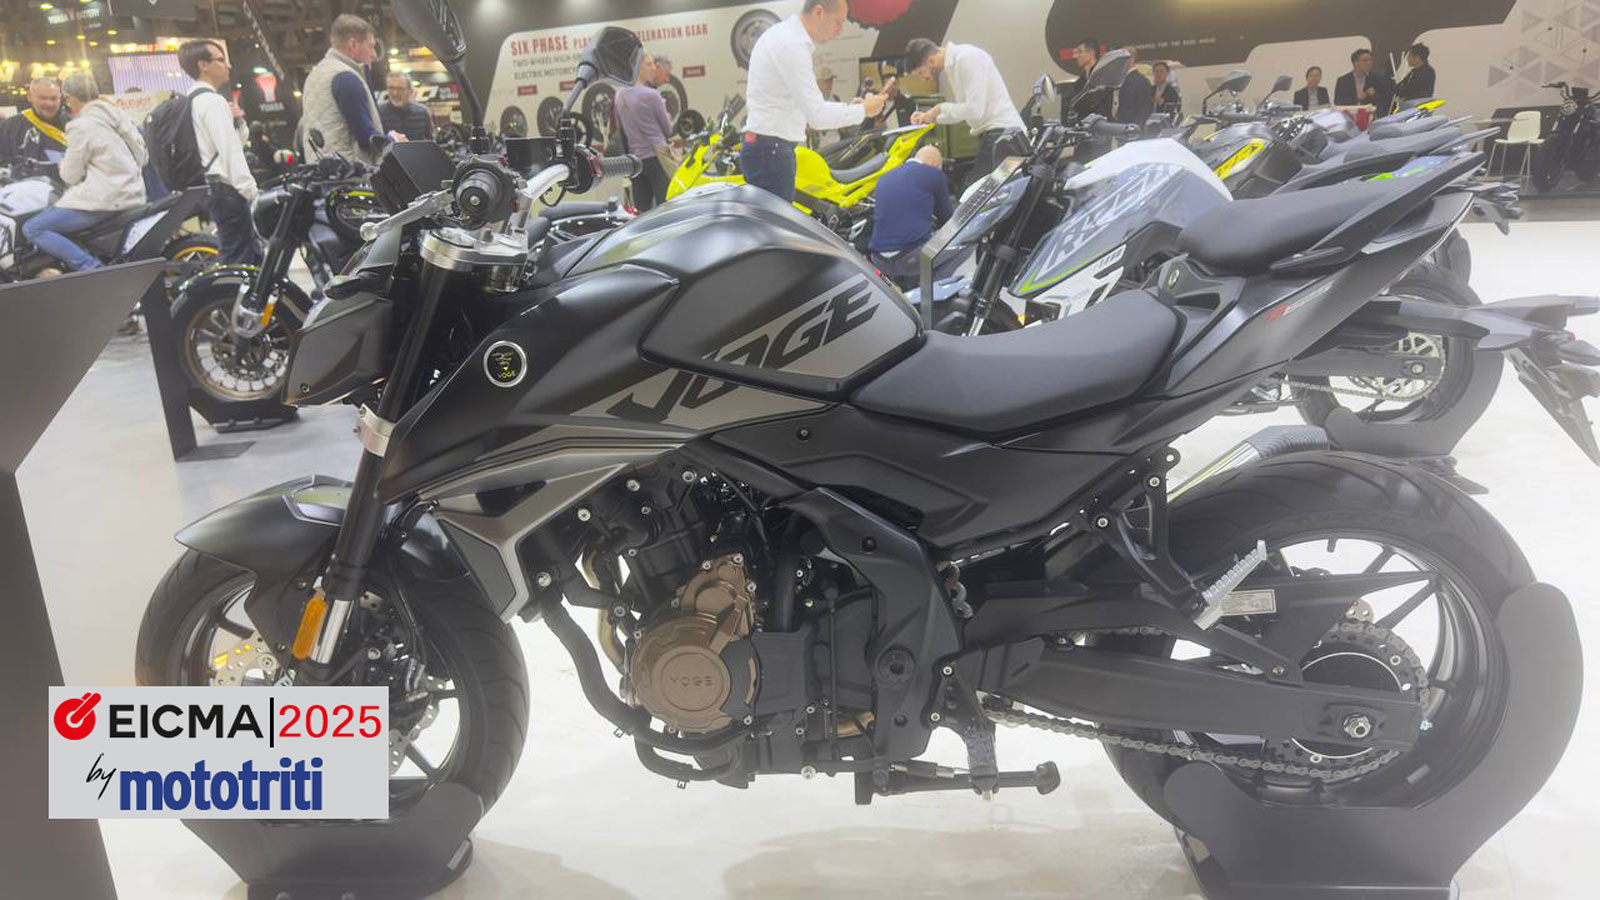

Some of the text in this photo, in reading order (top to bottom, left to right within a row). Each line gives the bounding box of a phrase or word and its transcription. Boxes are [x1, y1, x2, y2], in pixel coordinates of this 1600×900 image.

[511, 40, 529, 56] SIX
[532, 35, 568, 54] PHASE
[685, 23, 708, 37] GEAR
